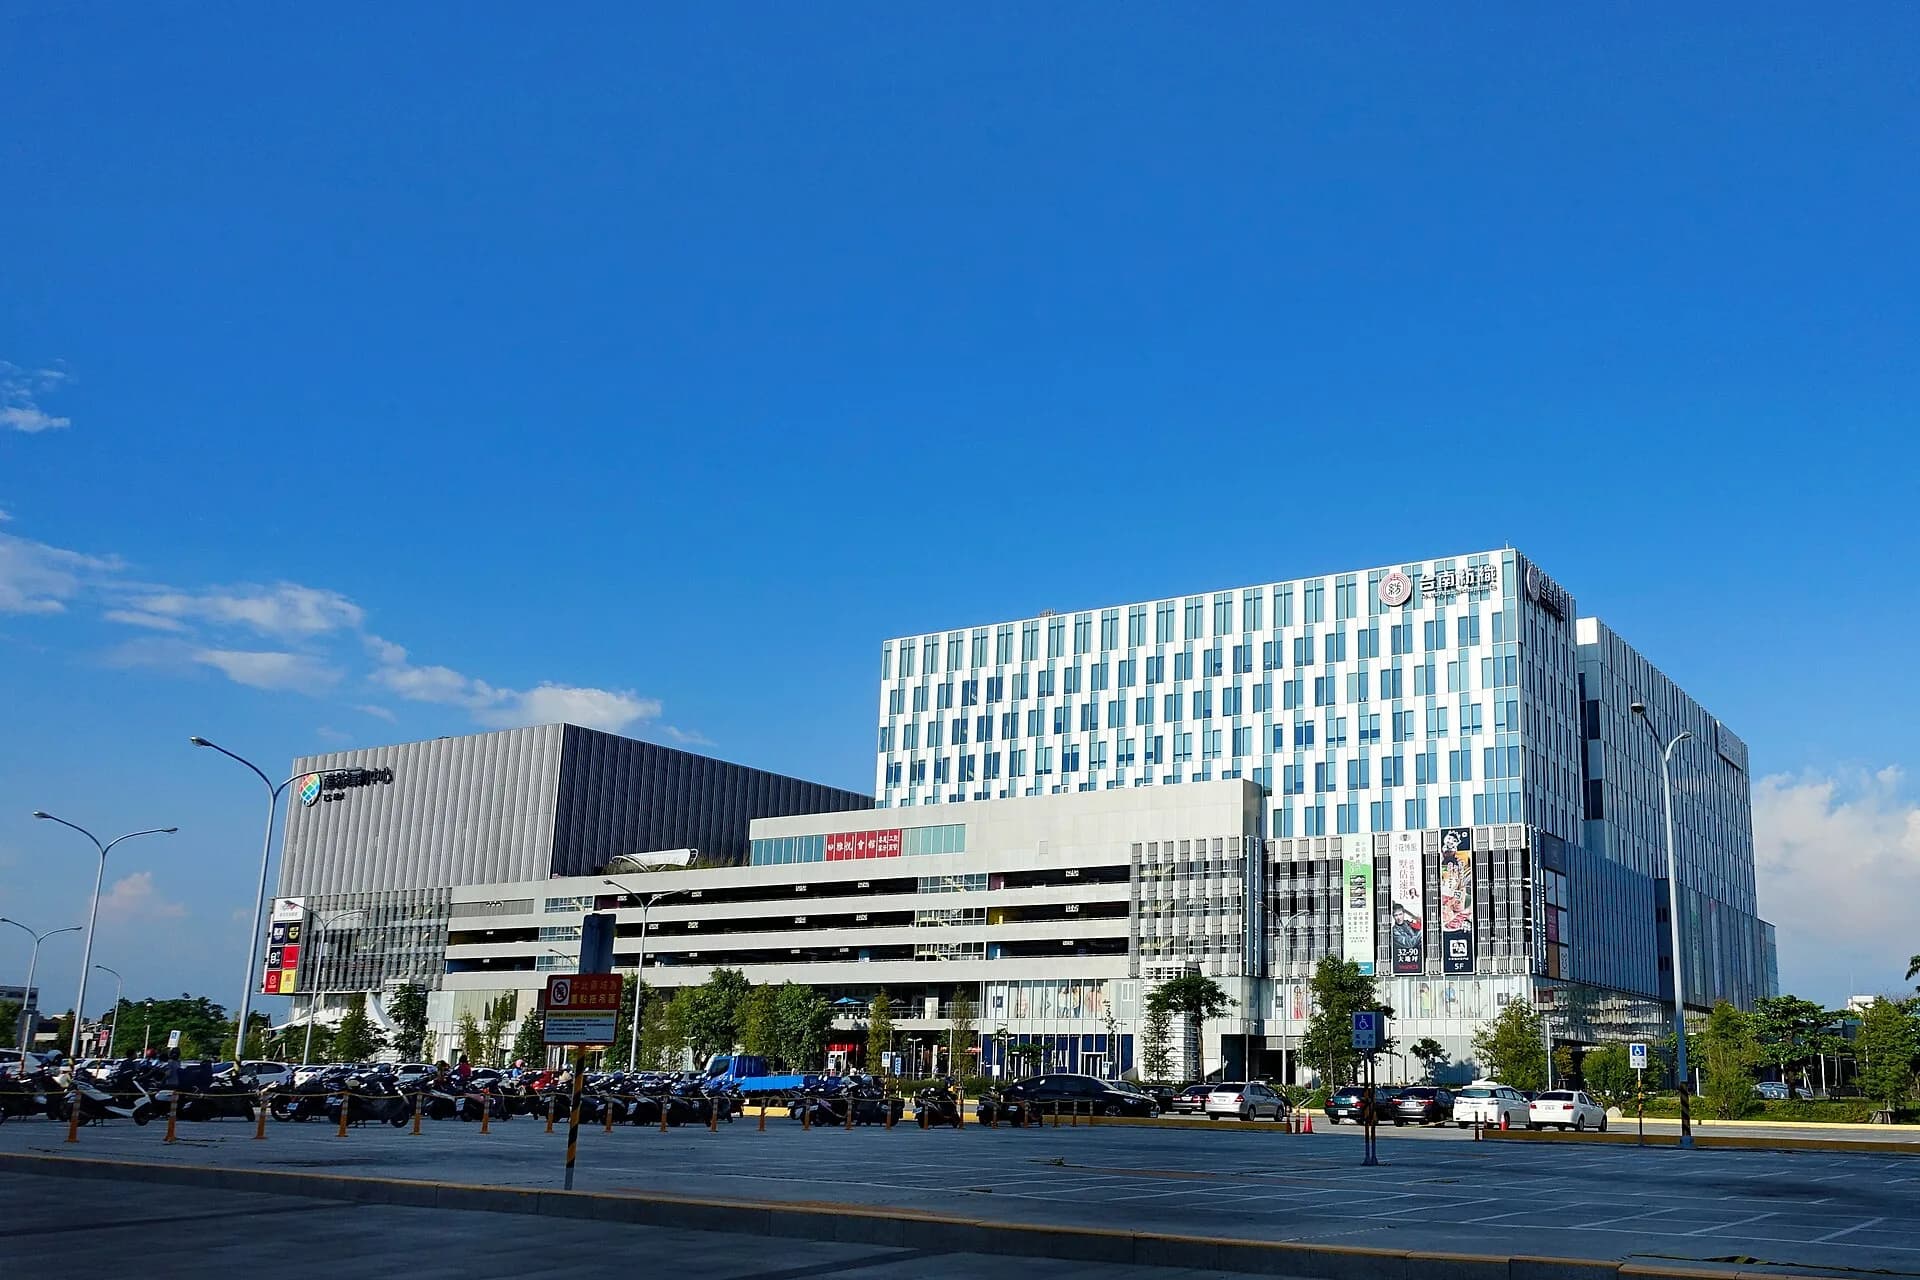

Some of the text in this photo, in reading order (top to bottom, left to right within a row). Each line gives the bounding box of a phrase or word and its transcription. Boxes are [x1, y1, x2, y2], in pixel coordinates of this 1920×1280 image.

[1419, 565, 1497, 591] 台南紡織
[1397, 948, 1419, 957] 32-90
